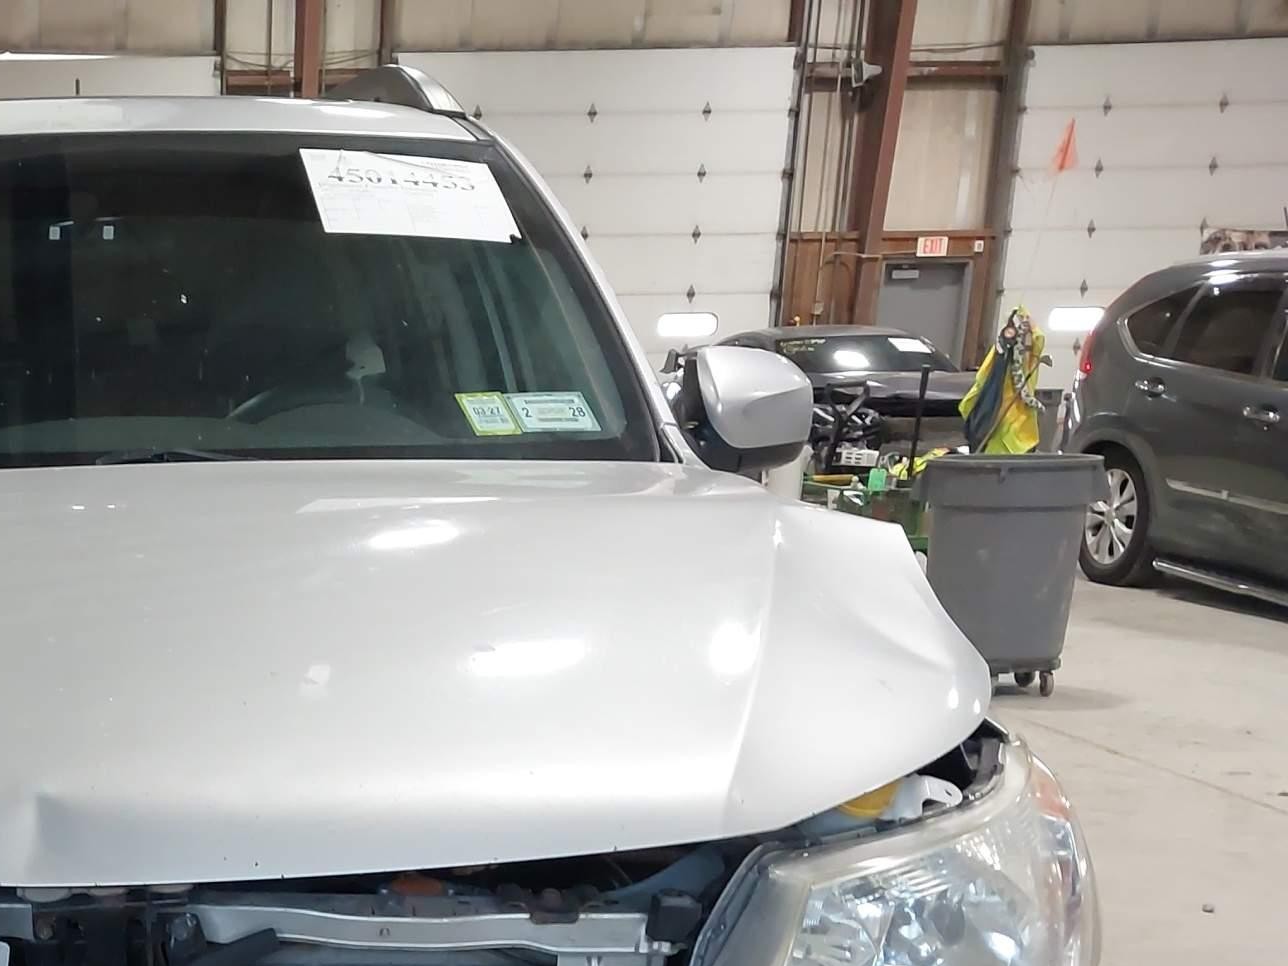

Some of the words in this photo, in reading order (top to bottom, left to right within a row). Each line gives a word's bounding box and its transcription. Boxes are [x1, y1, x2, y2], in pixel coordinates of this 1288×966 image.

[922, 238, 944, 254] EXIT
[522, 407, 533, 418] 2
[569, 407, 586, 418] 28
